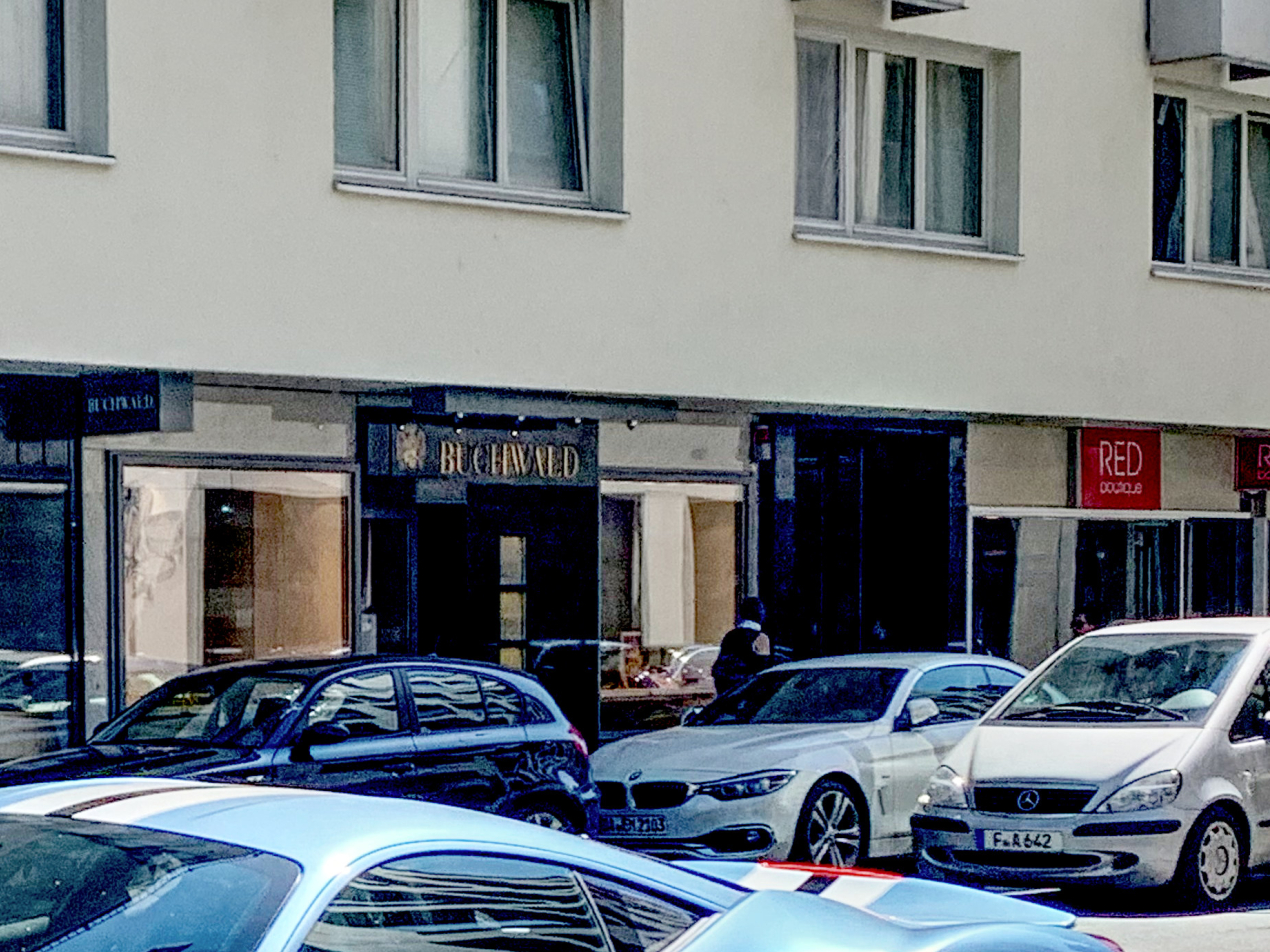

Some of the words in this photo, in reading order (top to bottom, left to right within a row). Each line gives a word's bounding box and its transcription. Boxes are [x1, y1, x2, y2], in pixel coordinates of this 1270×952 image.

[441, 441, 580, 478] BUCHWALD
[1099, 440, 1143, 476] RED
[1099, 480, 1143, 496] boutique
